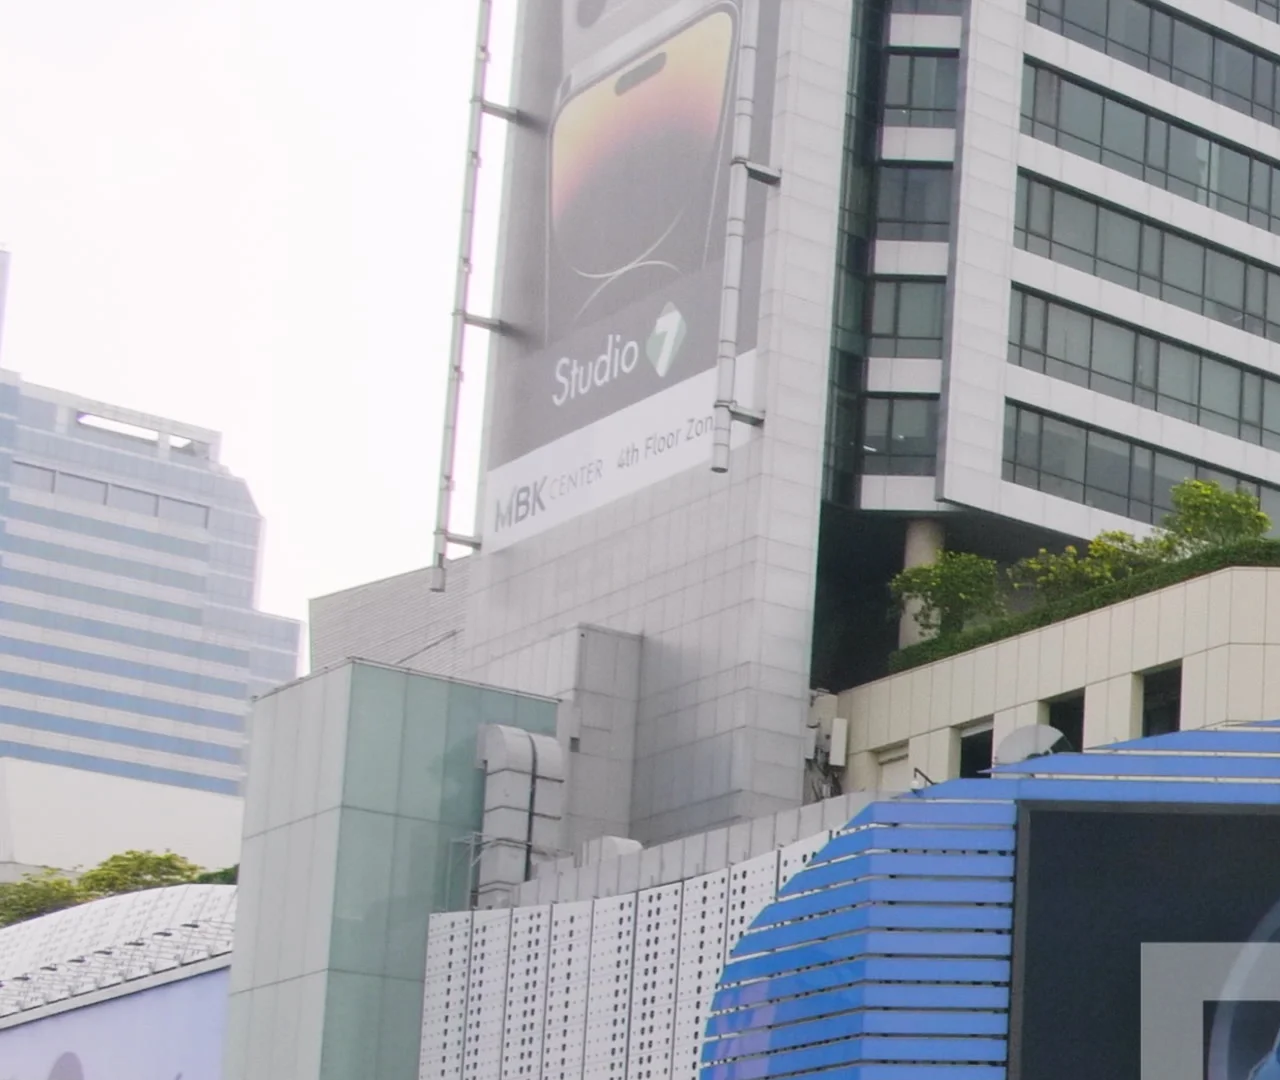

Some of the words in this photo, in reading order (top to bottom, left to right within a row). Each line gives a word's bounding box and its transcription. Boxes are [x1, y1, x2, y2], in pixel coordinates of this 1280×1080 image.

[552, 334, 638, 406] Studio
[494, 475, 547, 532] MBK
[549, 459, 604, 500] CENTER
[616, 442, 639, 469] 4th
[644, 428, 681, 460] Floor
[684, 415, 714, 442] Zon
